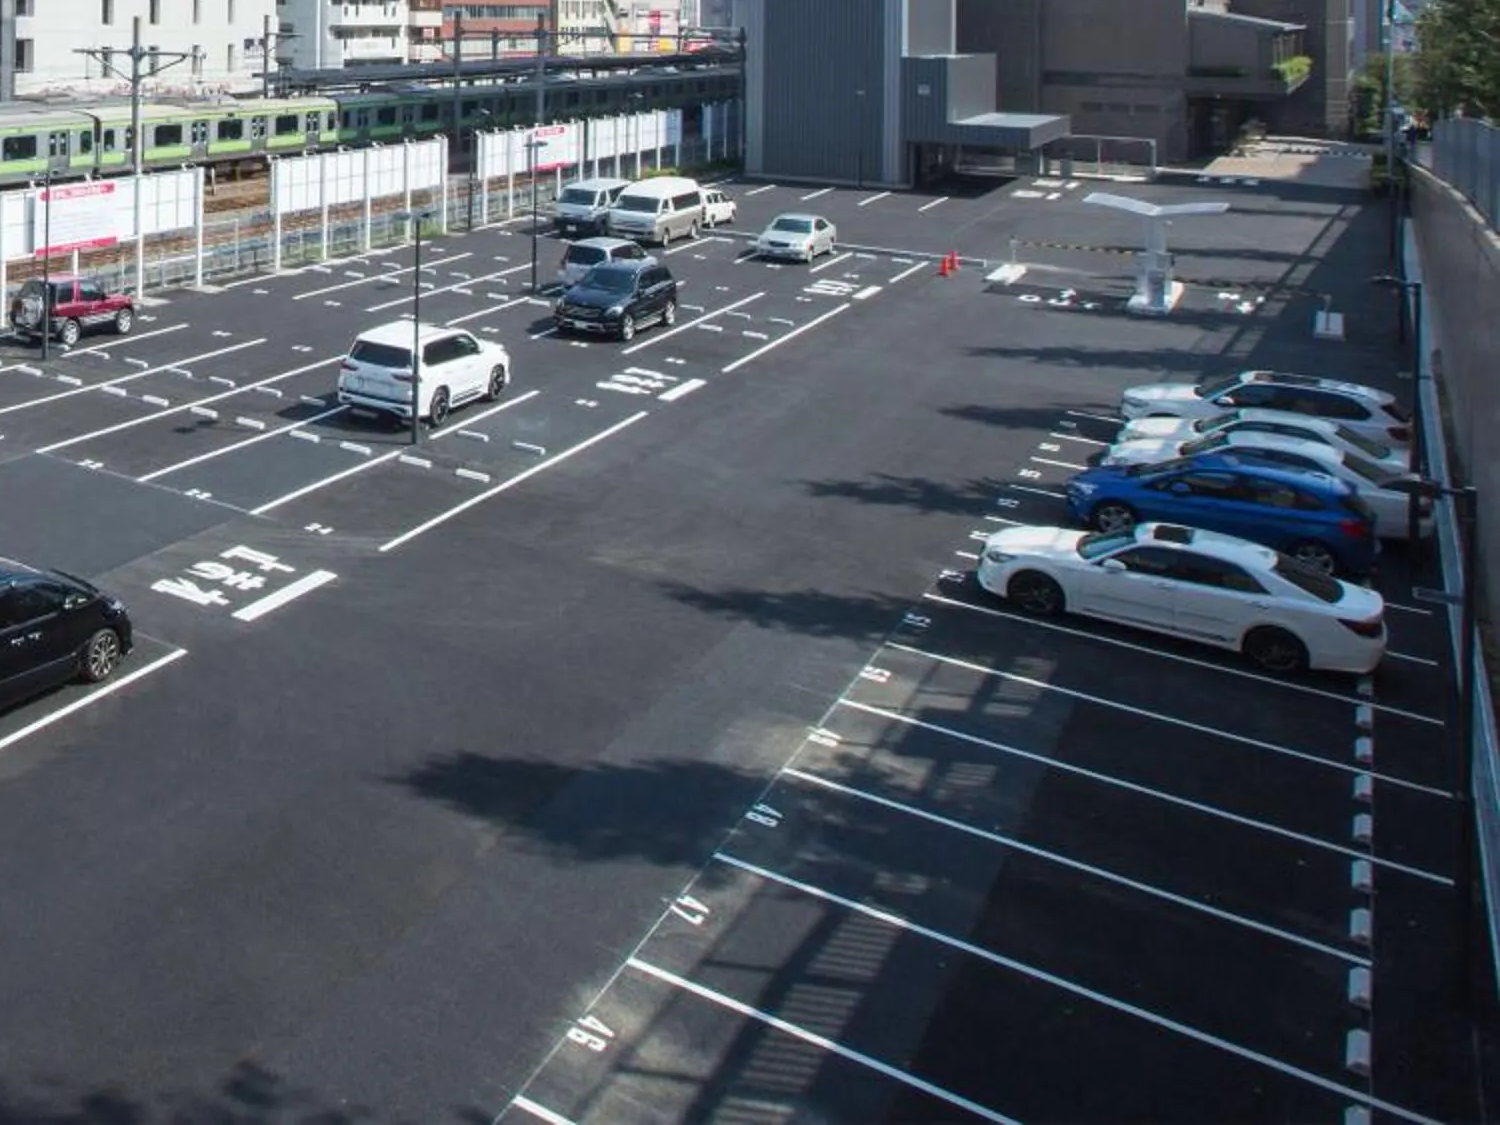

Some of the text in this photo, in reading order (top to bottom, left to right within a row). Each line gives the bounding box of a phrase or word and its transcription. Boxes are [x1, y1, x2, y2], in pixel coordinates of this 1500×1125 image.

[150, 545, 296, 606] 止まれ
[669, 895, 710, 926] 47
[566, 1014, 616, 1053] 46
